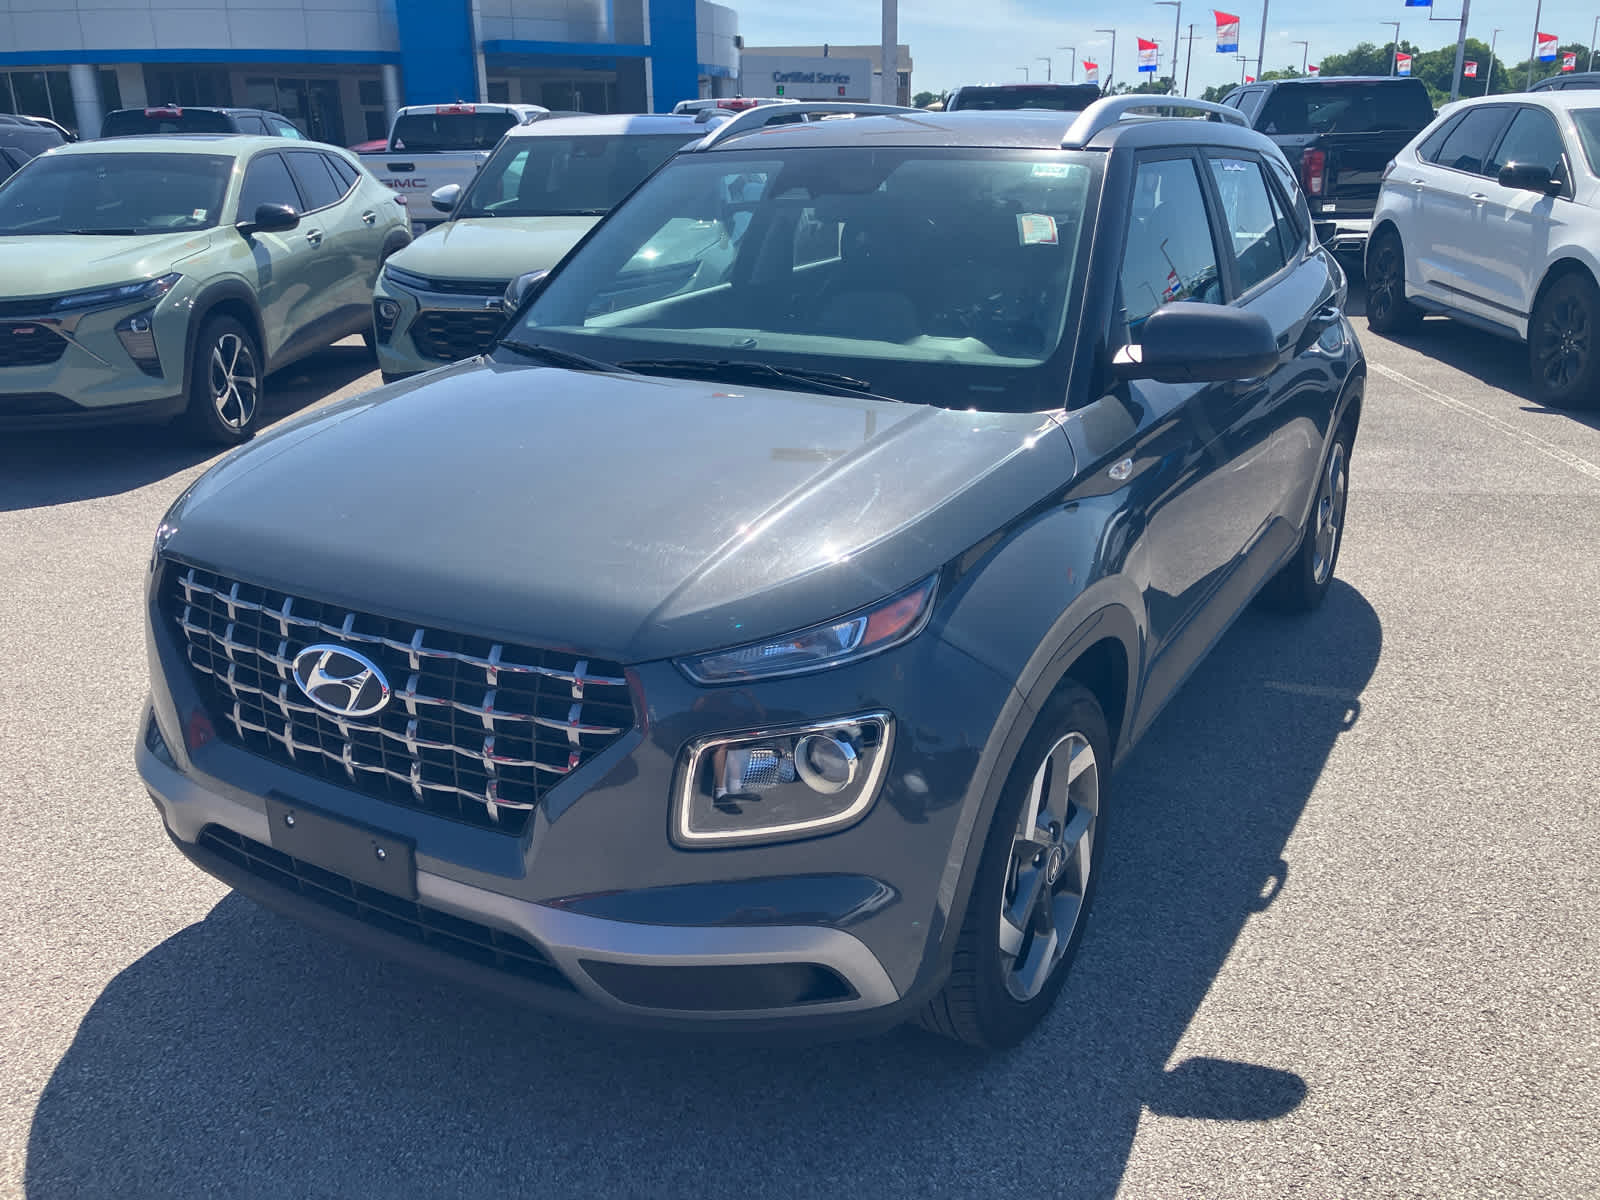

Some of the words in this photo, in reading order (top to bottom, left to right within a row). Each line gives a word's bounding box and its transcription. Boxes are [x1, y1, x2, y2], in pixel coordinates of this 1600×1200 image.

[772, 71, 815, 83] Certified
[816, 71, 850, 84] Service
[379, 177, 428, 189] GMC
